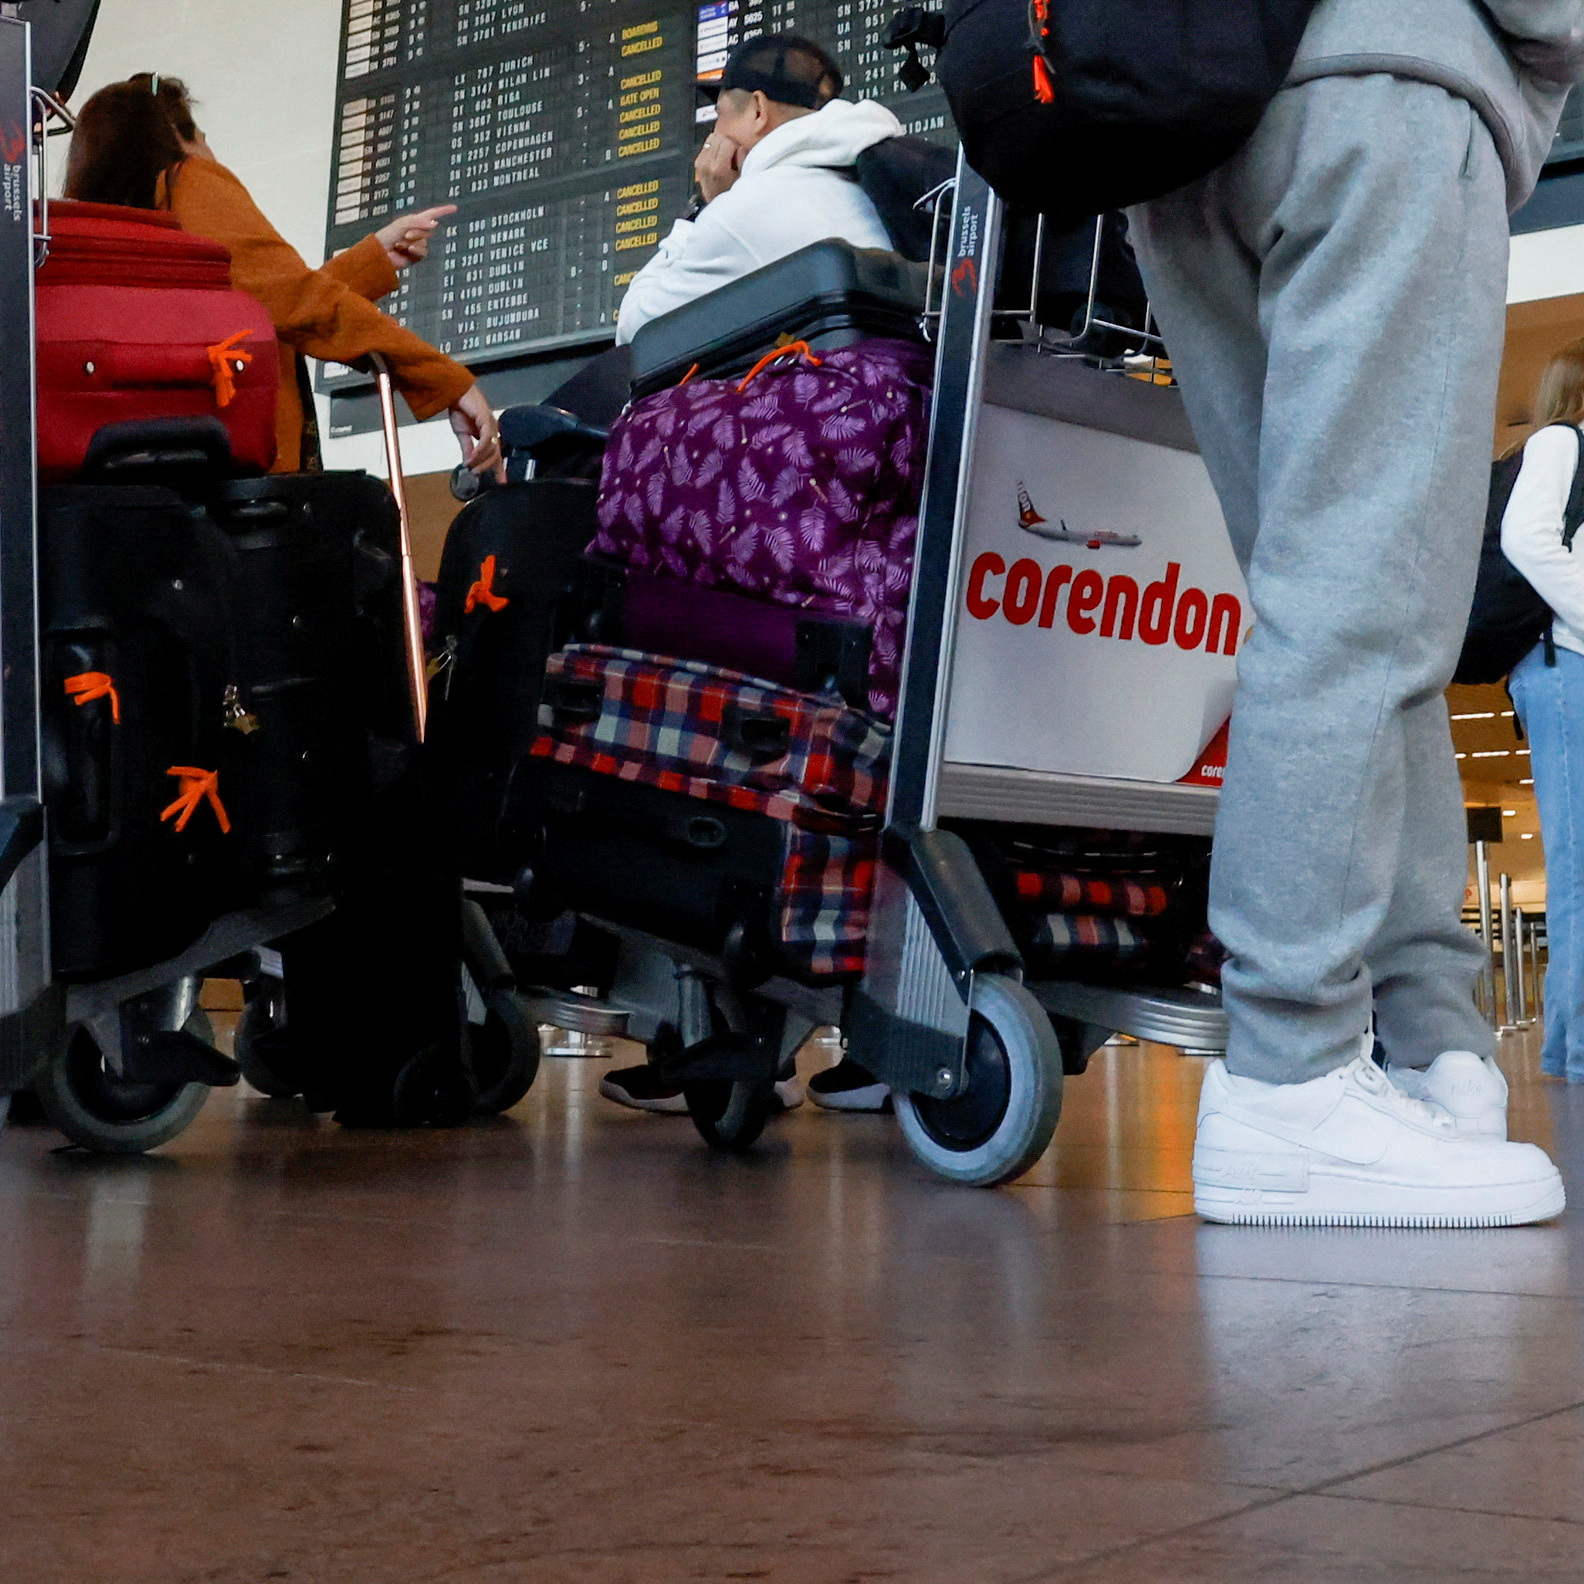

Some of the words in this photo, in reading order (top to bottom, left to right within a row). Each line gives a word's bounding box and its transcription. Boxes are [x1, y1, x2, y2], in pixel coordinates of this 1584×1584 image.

[621, 36, 662, 56] CANCELLED
[497, 100, 542, 121] TOULOUSE
[495, 131, 552, 154] COPENHAGEN
[619, 103, 660, 123] CANCELLED
[496, 120, 530, 138] VIENNA
[618, 120, 660, 140] CANCELLED
[618, 137, 659, 157] CANCELLED
[491, 206, 543, 227] STOCKHOLM
[616, 180, 658, 199] CANCELLED
[616, 197, 658, 216] CANCELLED
[490, 243, 523, 260] VENICE
[615, 215, 657, 233] CANCELLED
[615, 232, 657, 250] CANCELLED
[957, 205, 972, 258] brussels
[967, 213, 979, 257] airport
[488, 277, 523, 294] DUBLIN
[965, 550, 1242, 657] corendon
